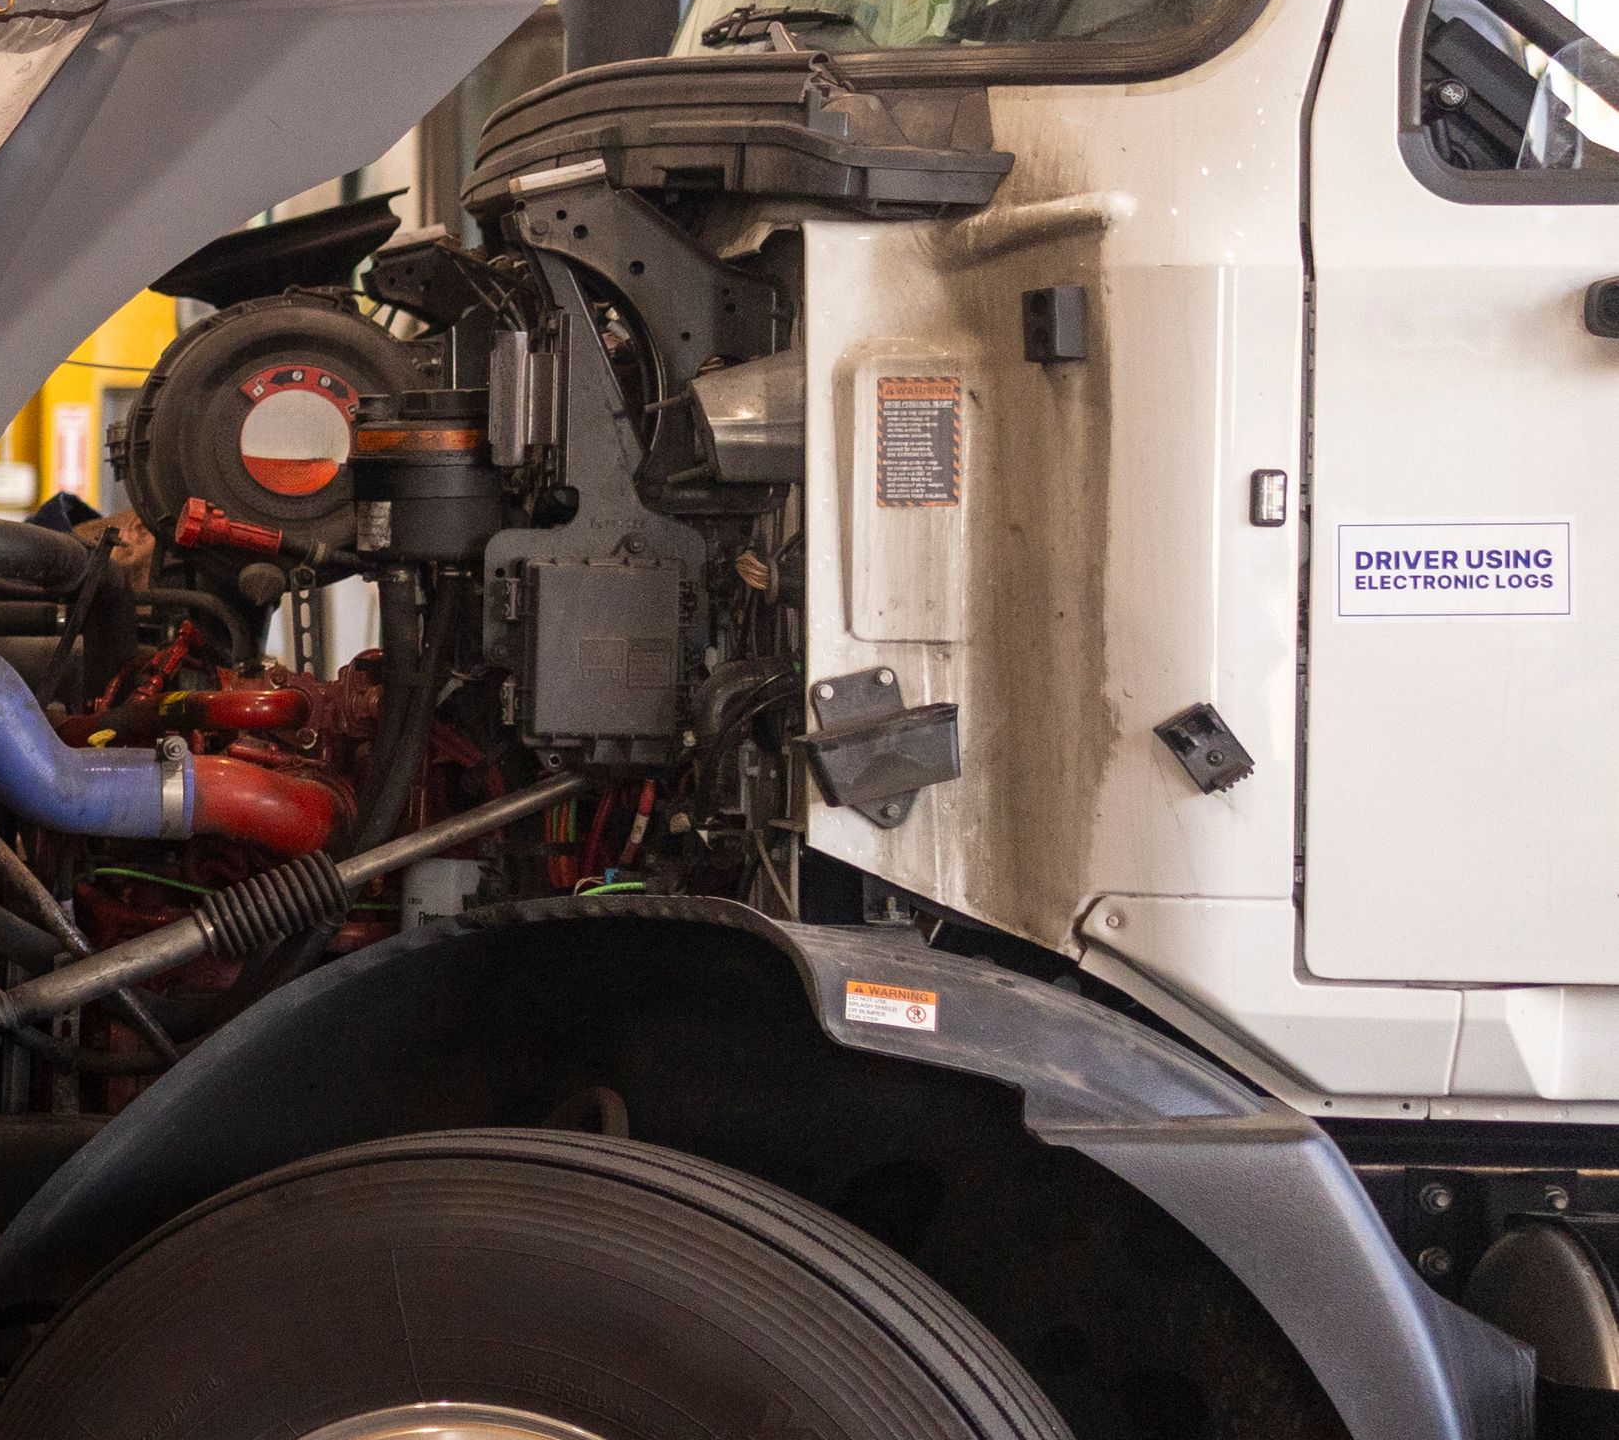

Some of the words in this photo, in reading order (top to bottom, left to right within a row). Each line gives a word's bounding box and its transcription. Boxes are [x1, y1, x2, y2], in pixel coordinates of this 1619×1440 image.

[1355, 551, 1458, 570] DRIVER
[1466, 549, 1552, 569] USING
[1355, 574, 1489, 590] ELECTRONIC
[1495, 574, 1553, 588] LOGS
[869, 985, 928, 1002] WARNING
